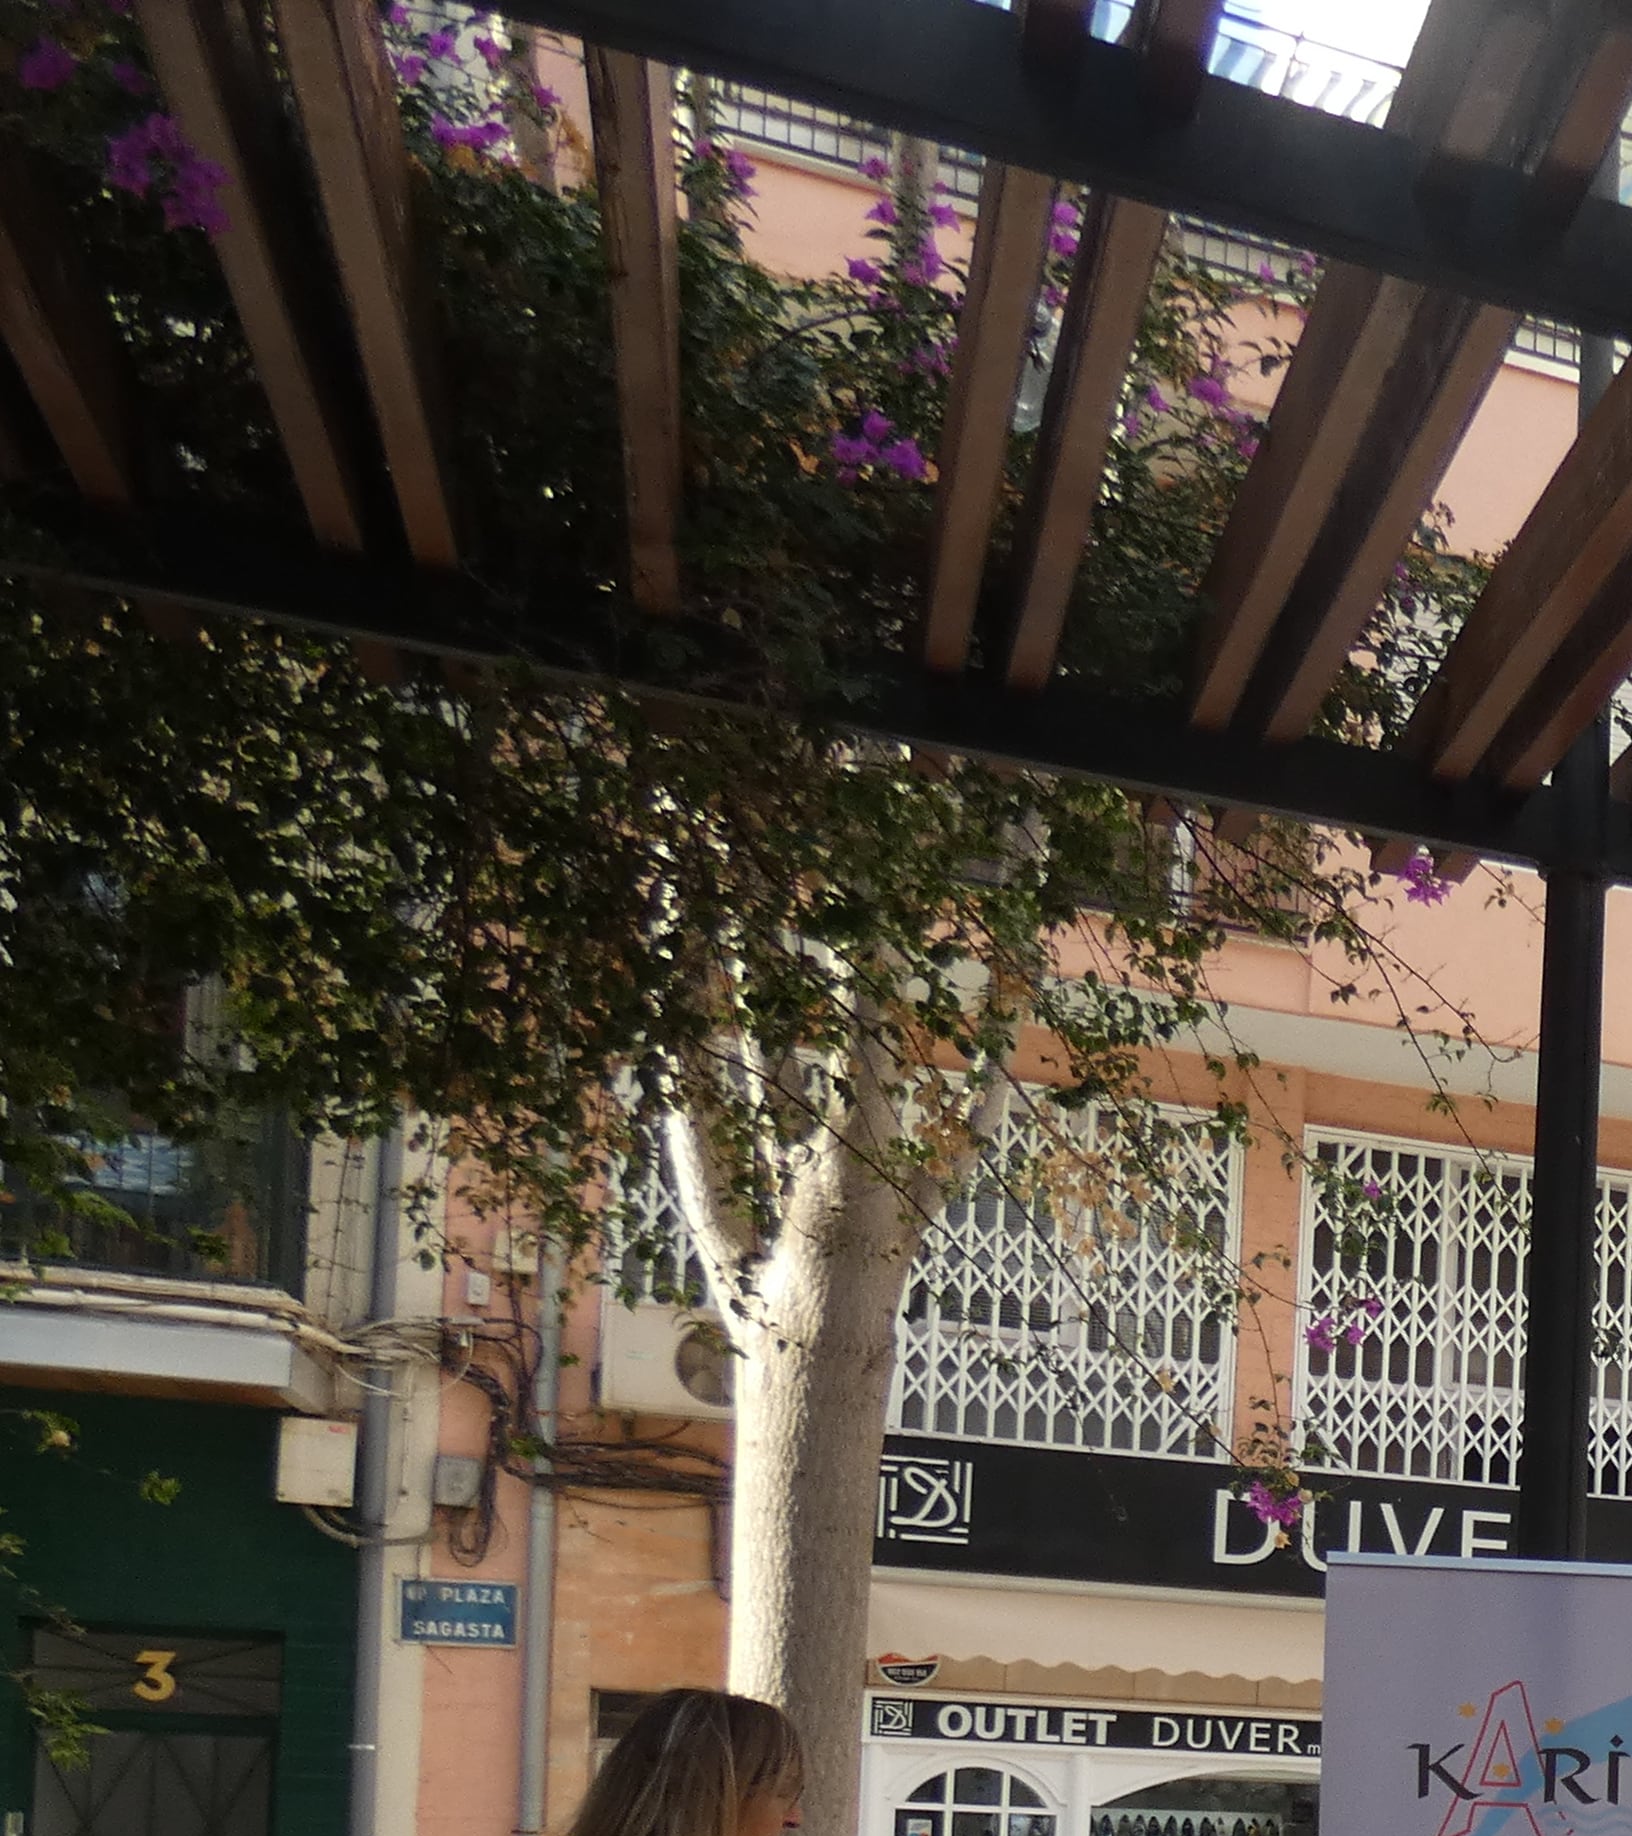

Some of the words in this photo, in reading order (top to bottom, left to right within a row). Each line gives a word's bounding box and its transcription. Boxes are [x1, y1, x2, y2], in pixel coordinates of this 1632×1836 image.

[1213, 1489, 1512, 1573] DUVE
[440, 1586, 506, 1605] PLAZA
[412, 1620, 506, 1639] SAGASTA
[133, 1650, 177, 1702] 3
[937, 1702, 1118, 1746] OUTLET
[1151, 1716, 1303, 1755] DUVER
